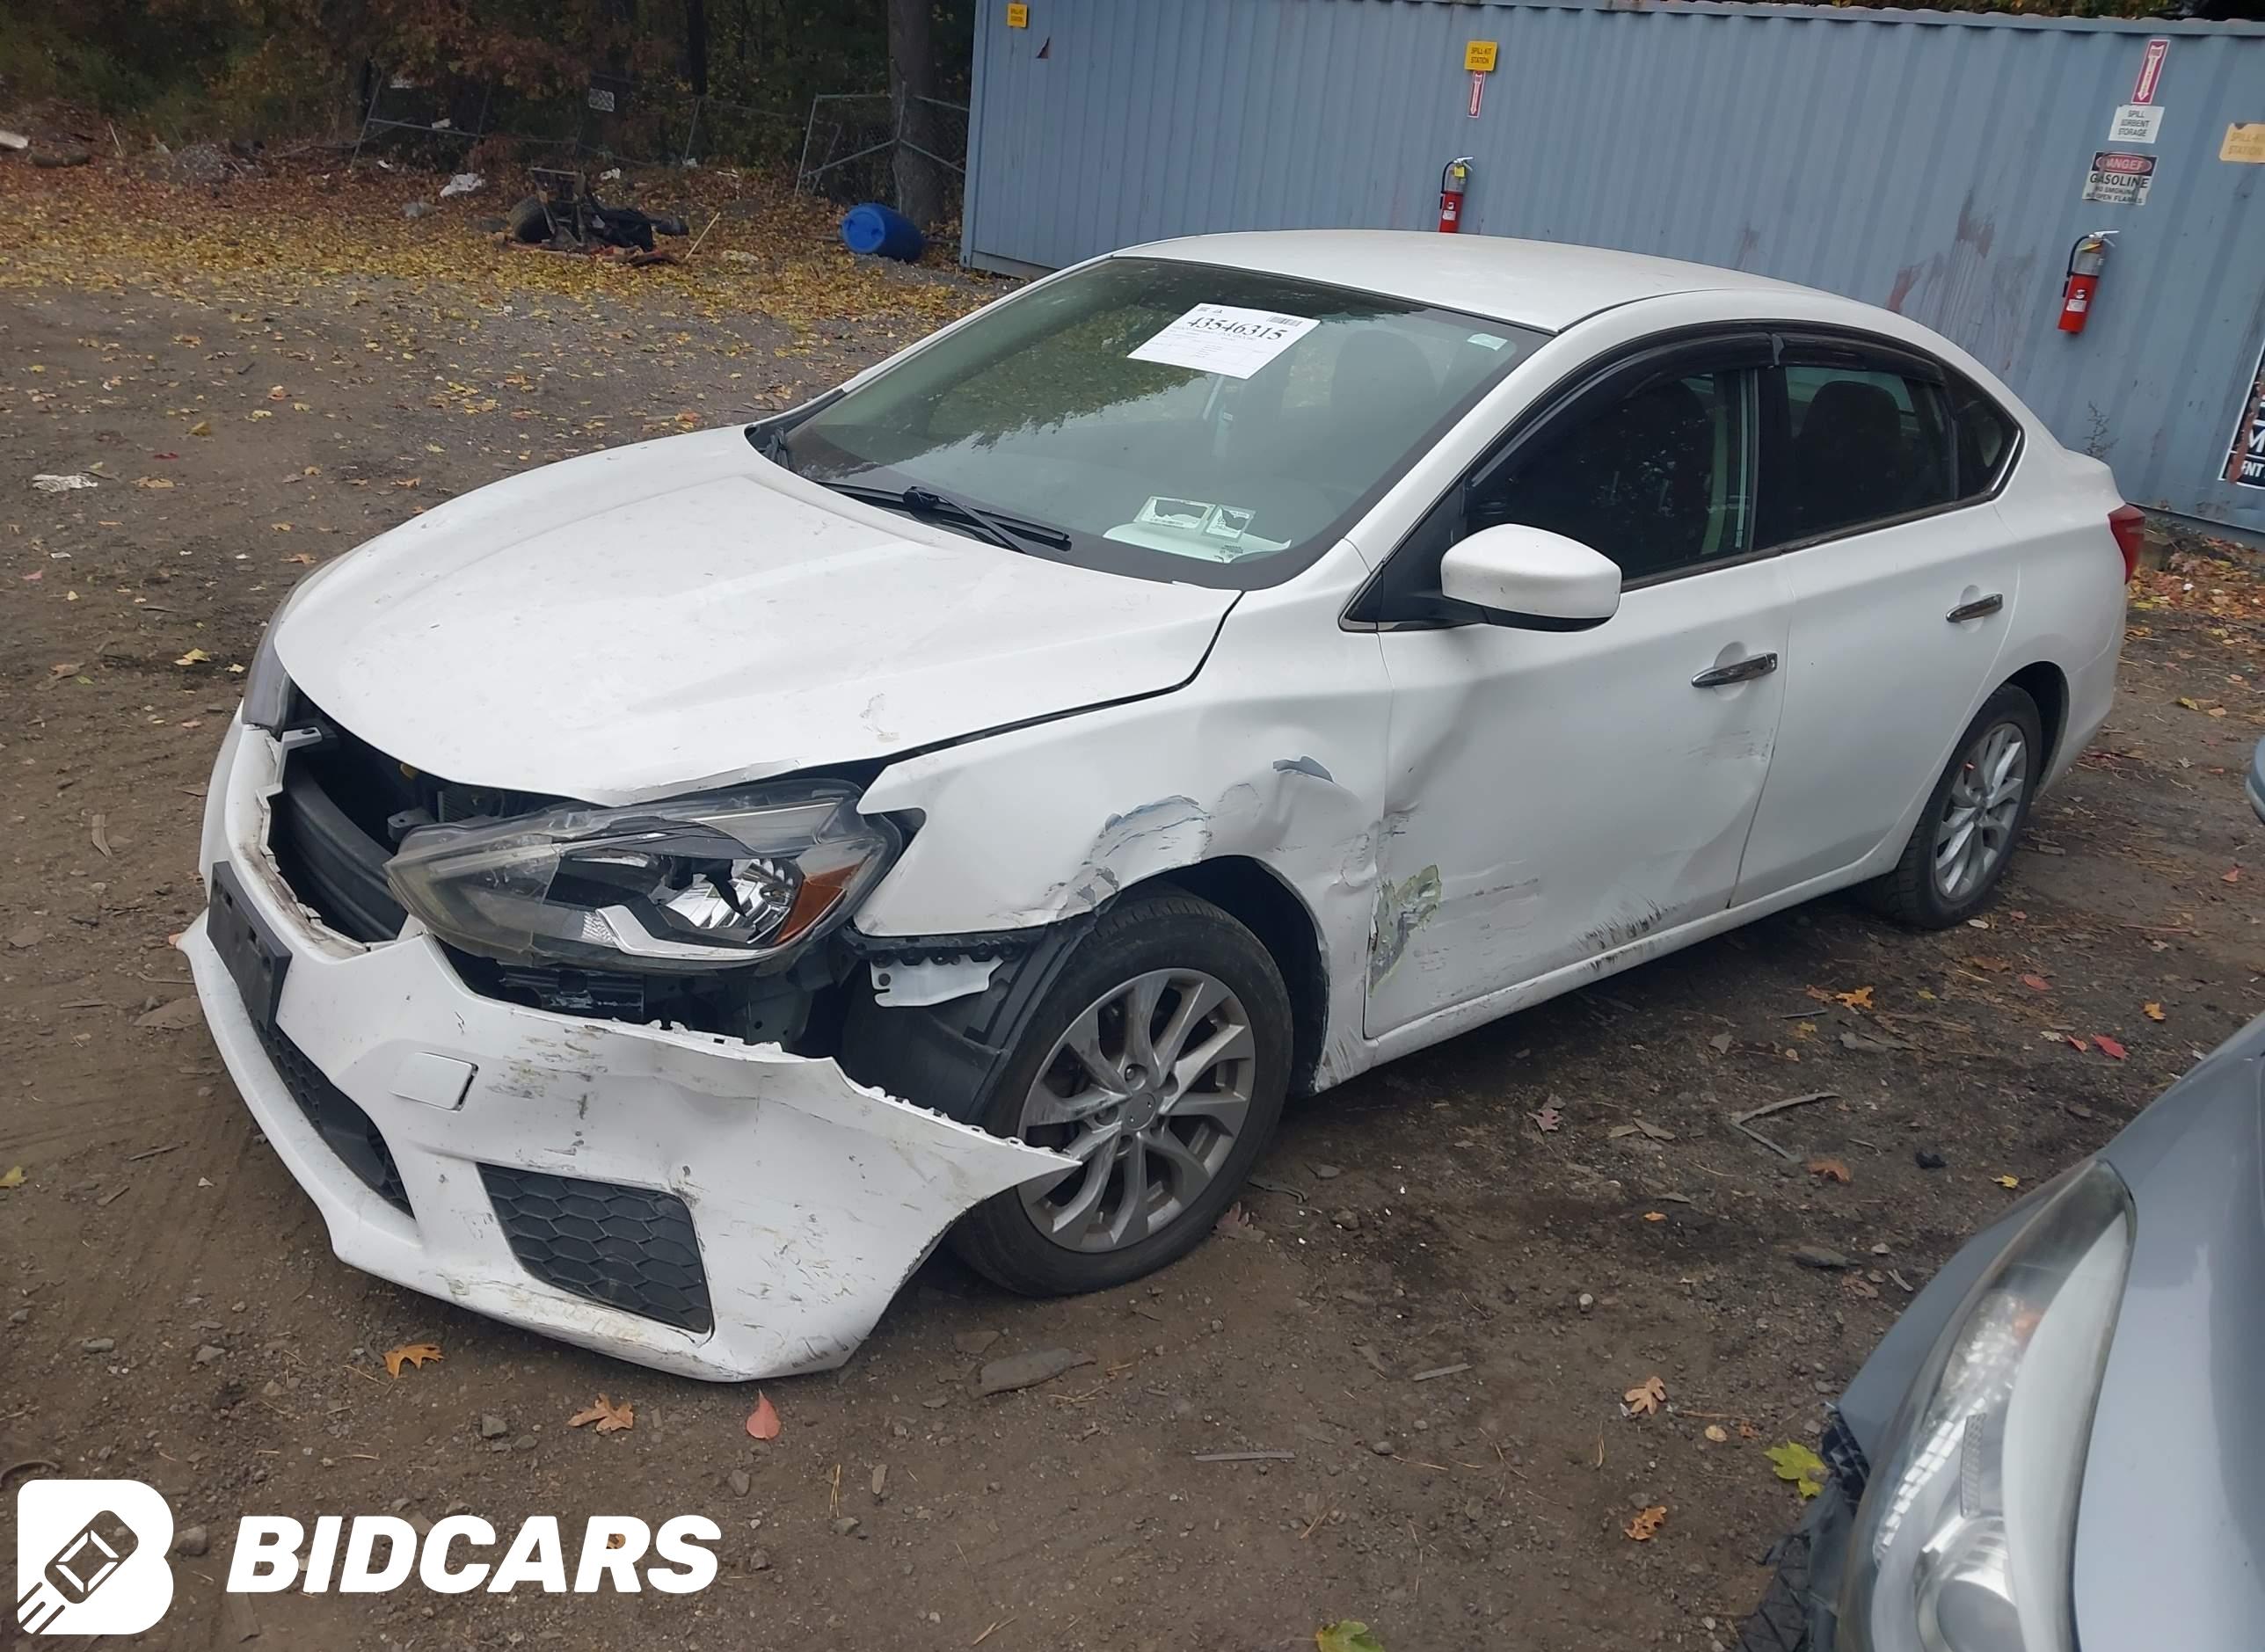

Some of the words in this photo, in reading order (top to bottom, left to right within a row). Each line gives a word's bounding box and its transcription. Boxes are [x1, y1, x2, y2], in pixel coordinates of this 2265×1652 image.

[2117, 127, 2148, 136] STORAGE
[2090, 173, 2149, 188] GASOLINE
[1188, 317, 1288, 340] 43546315
[2241, 461, 2264, 477] ENT
